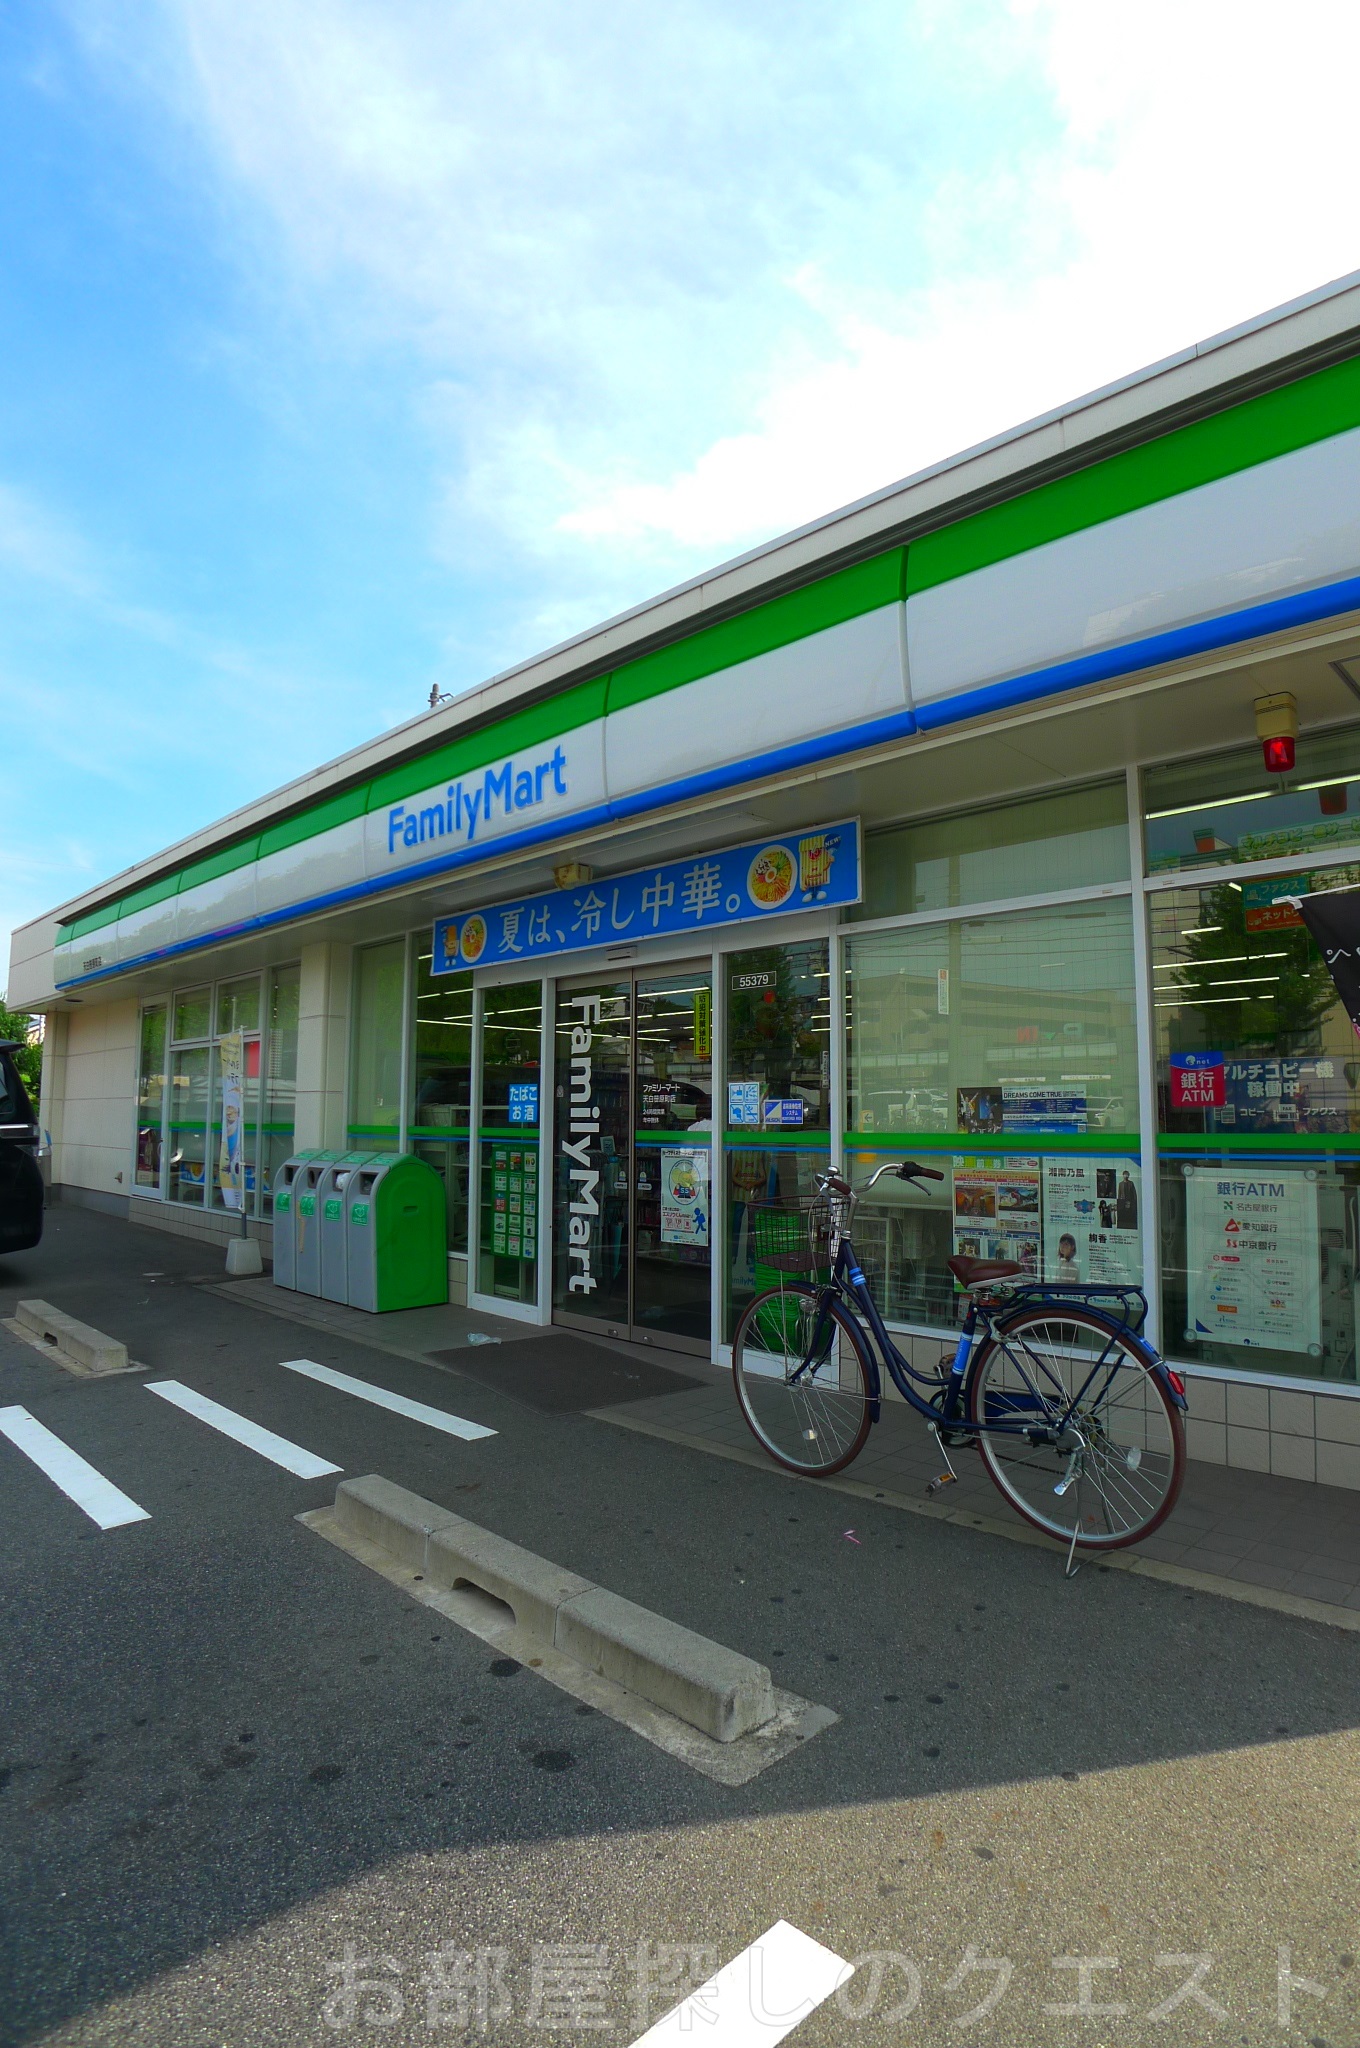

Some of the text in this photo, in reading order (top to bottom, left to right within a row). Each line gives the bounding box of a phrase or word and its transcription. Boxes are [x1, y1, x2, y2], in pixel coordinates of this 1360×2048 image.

[388, 745, 567, 854] FamilyMart
[497, 861, 741, 955] 夏は、冷し中華。
[739, 973, 769, 988] 55379
[1180, 1071, 1215, 1089] 銀行
[509, 1086, 538, 1103] たばこ
[642, 1083, 681, 1093] ファミリーマート
[1003, 1091, 1028, 1099] DREAMS
[1046, 1090, 1063, 1098] TRUE
[1247, 1081, 1300, 1098] 稼働中
[1181, 1090, 1215, 1102] ATM
[511, 1104, 535, 1121] お酒
[1240, 1107, 1265, 1117] コピー
[1302, 1107, 1338, 1116] ファクス
[562, 994, 601, 1295] FamilyMart
[1048, 1167, 1085, 1178] 湘南乃風
[1217, 1181, 1285, 1198] 銀行ATM
[1236, 1202, 1278, 1213] 名古屋銀行
[1242, 1222, 1278, 1233] 愛知銀行
[1238, 1240, 1278, 1251] 中京銀行
